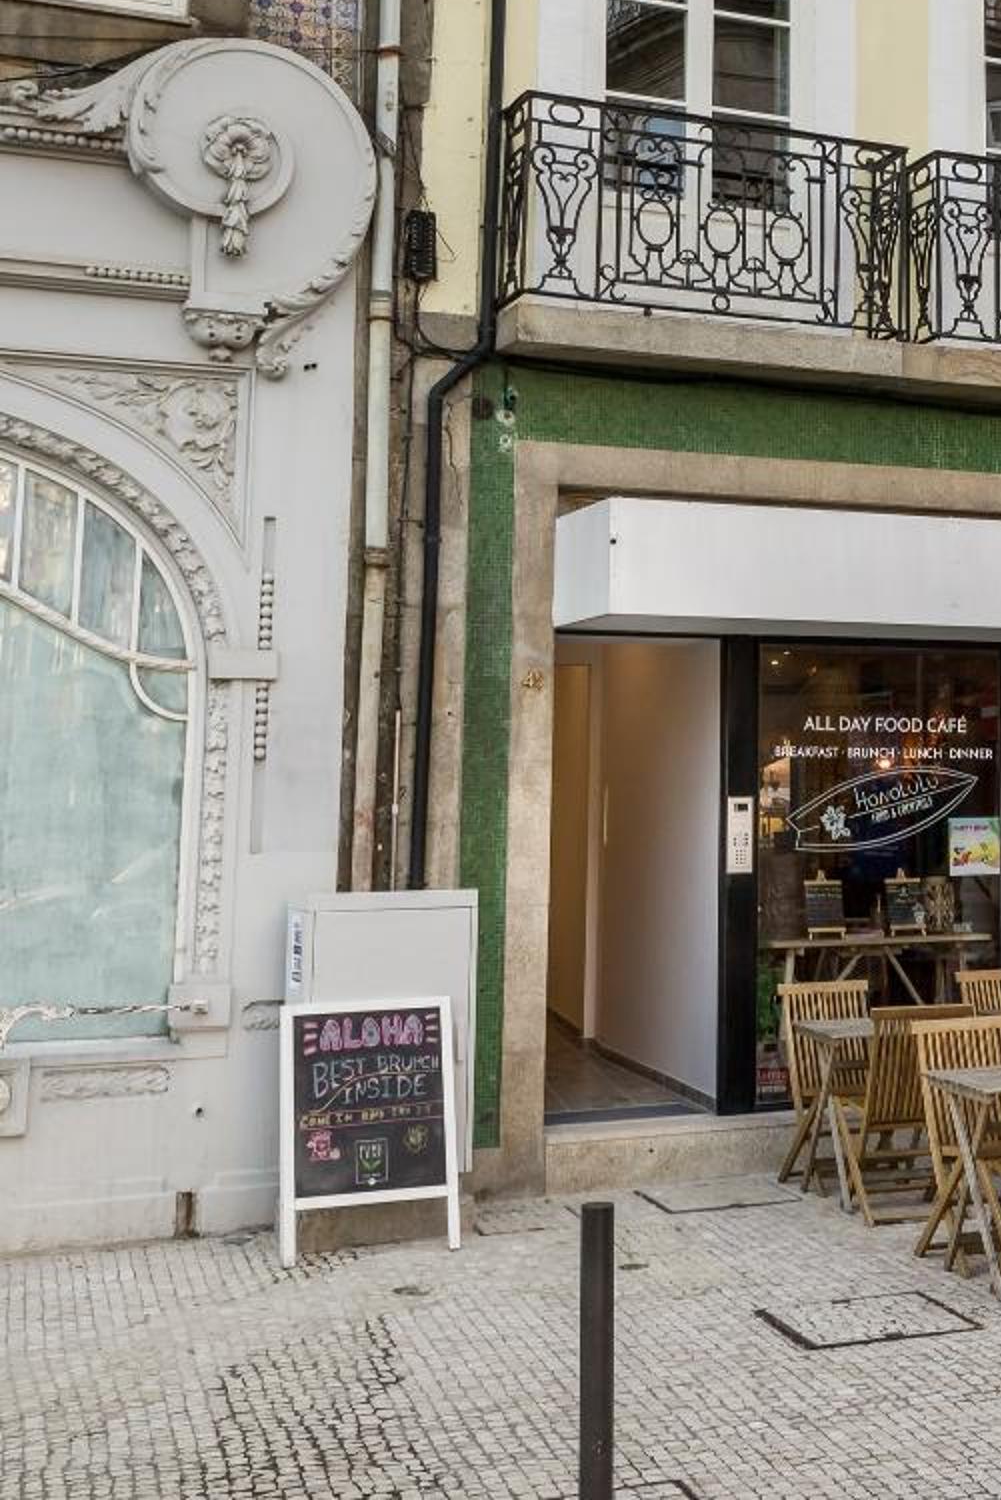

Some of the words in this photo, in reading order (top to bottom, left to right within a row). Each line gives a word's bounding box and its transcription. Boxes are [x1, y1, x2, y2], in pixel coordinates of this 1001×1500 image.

[803, 716, 836, 732] ALL
[839, 716, 871, 732] DAY
[875, 716, 922, 732] FOOD
[926, 714, 967, 733] CAFÉ
[774, 746, 838, 759] BREAKFAST
[847, 746, 895, 759] BRUNCH
[903, 746, 943, 759] LUNCH
[949, 747, 993, 760] DINNER
[854, 774, 940, 811] HONOLULU
[319, 1013, 424, 1052] ALOHA
[312, 1057, 367, 1100] BEST
[342, 1073, 427, 1104] INSIDE
